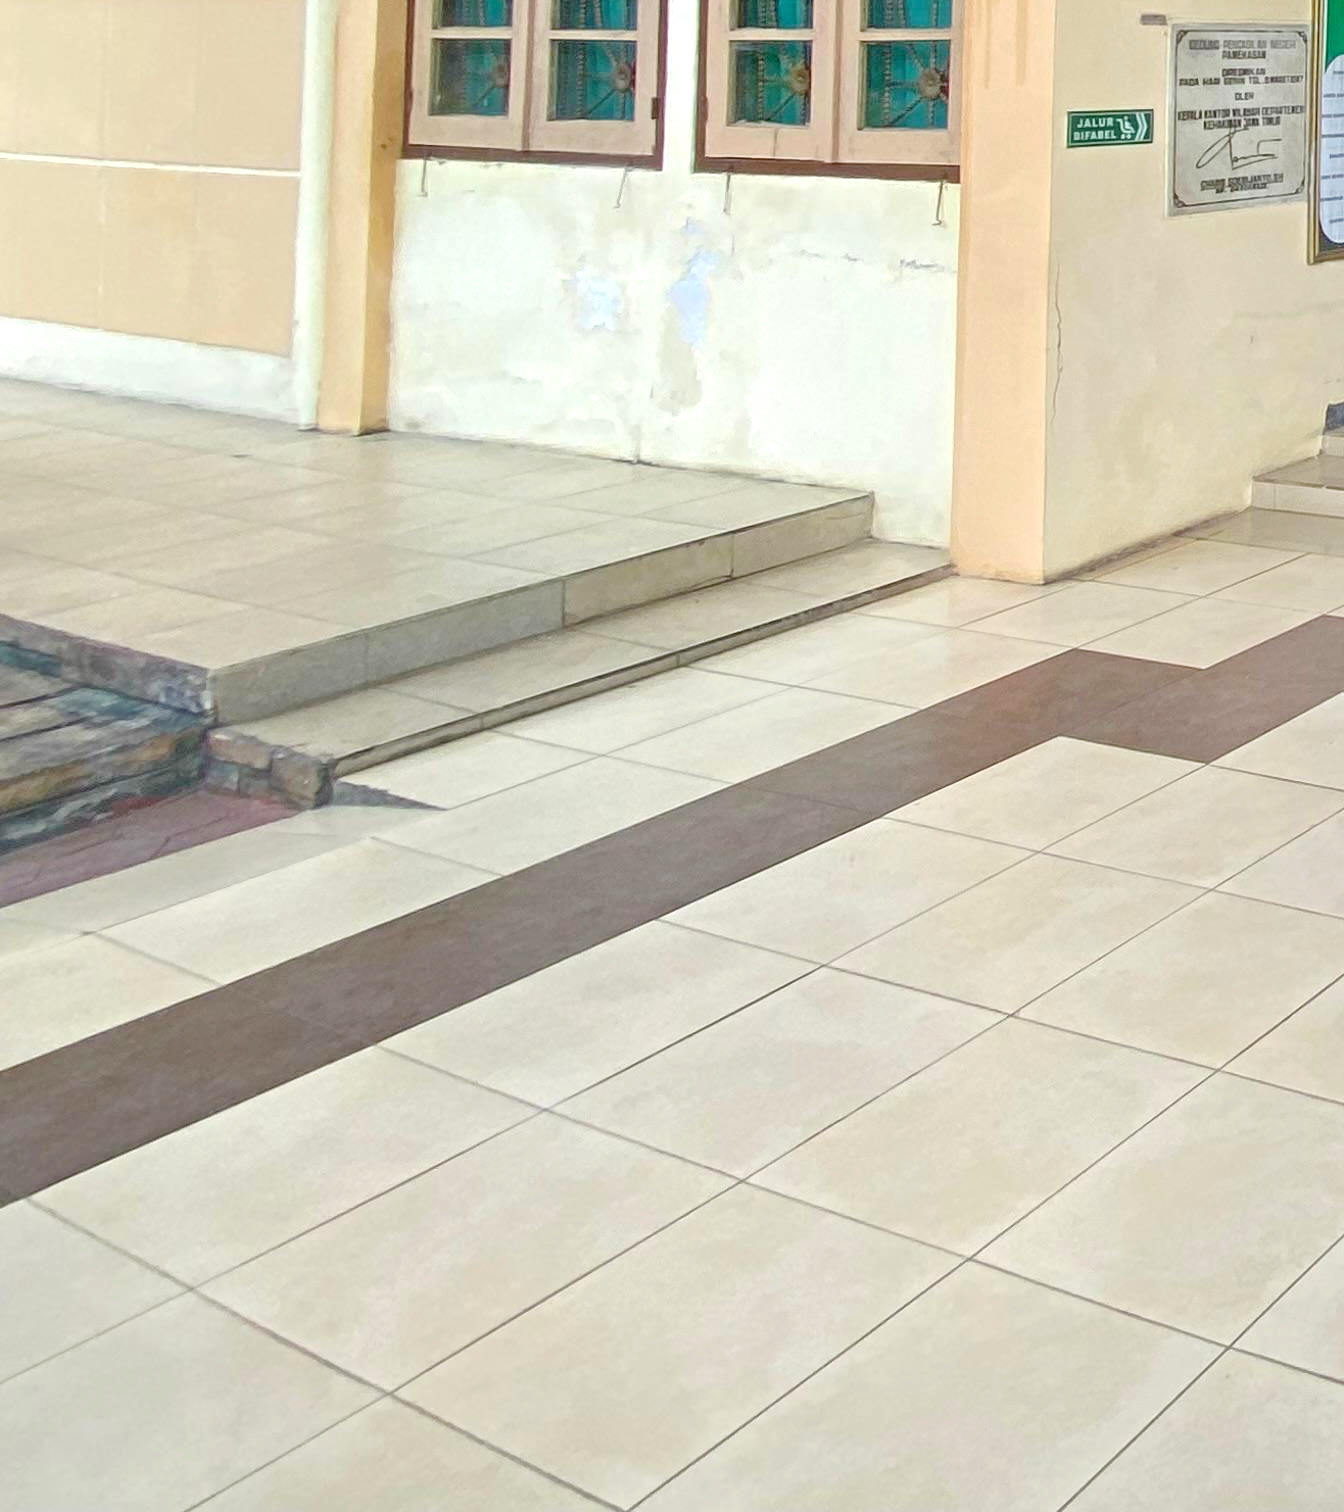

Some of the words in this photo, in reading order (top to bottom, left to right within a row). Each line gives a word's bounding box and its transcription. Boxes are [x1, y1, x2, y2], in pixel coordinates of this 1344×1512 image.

[1234, 92, 1255, 101] OLEH
[1077, 117, 1114, 129] JALUR
[1073, 130, 1117, 141] DIFABEL
